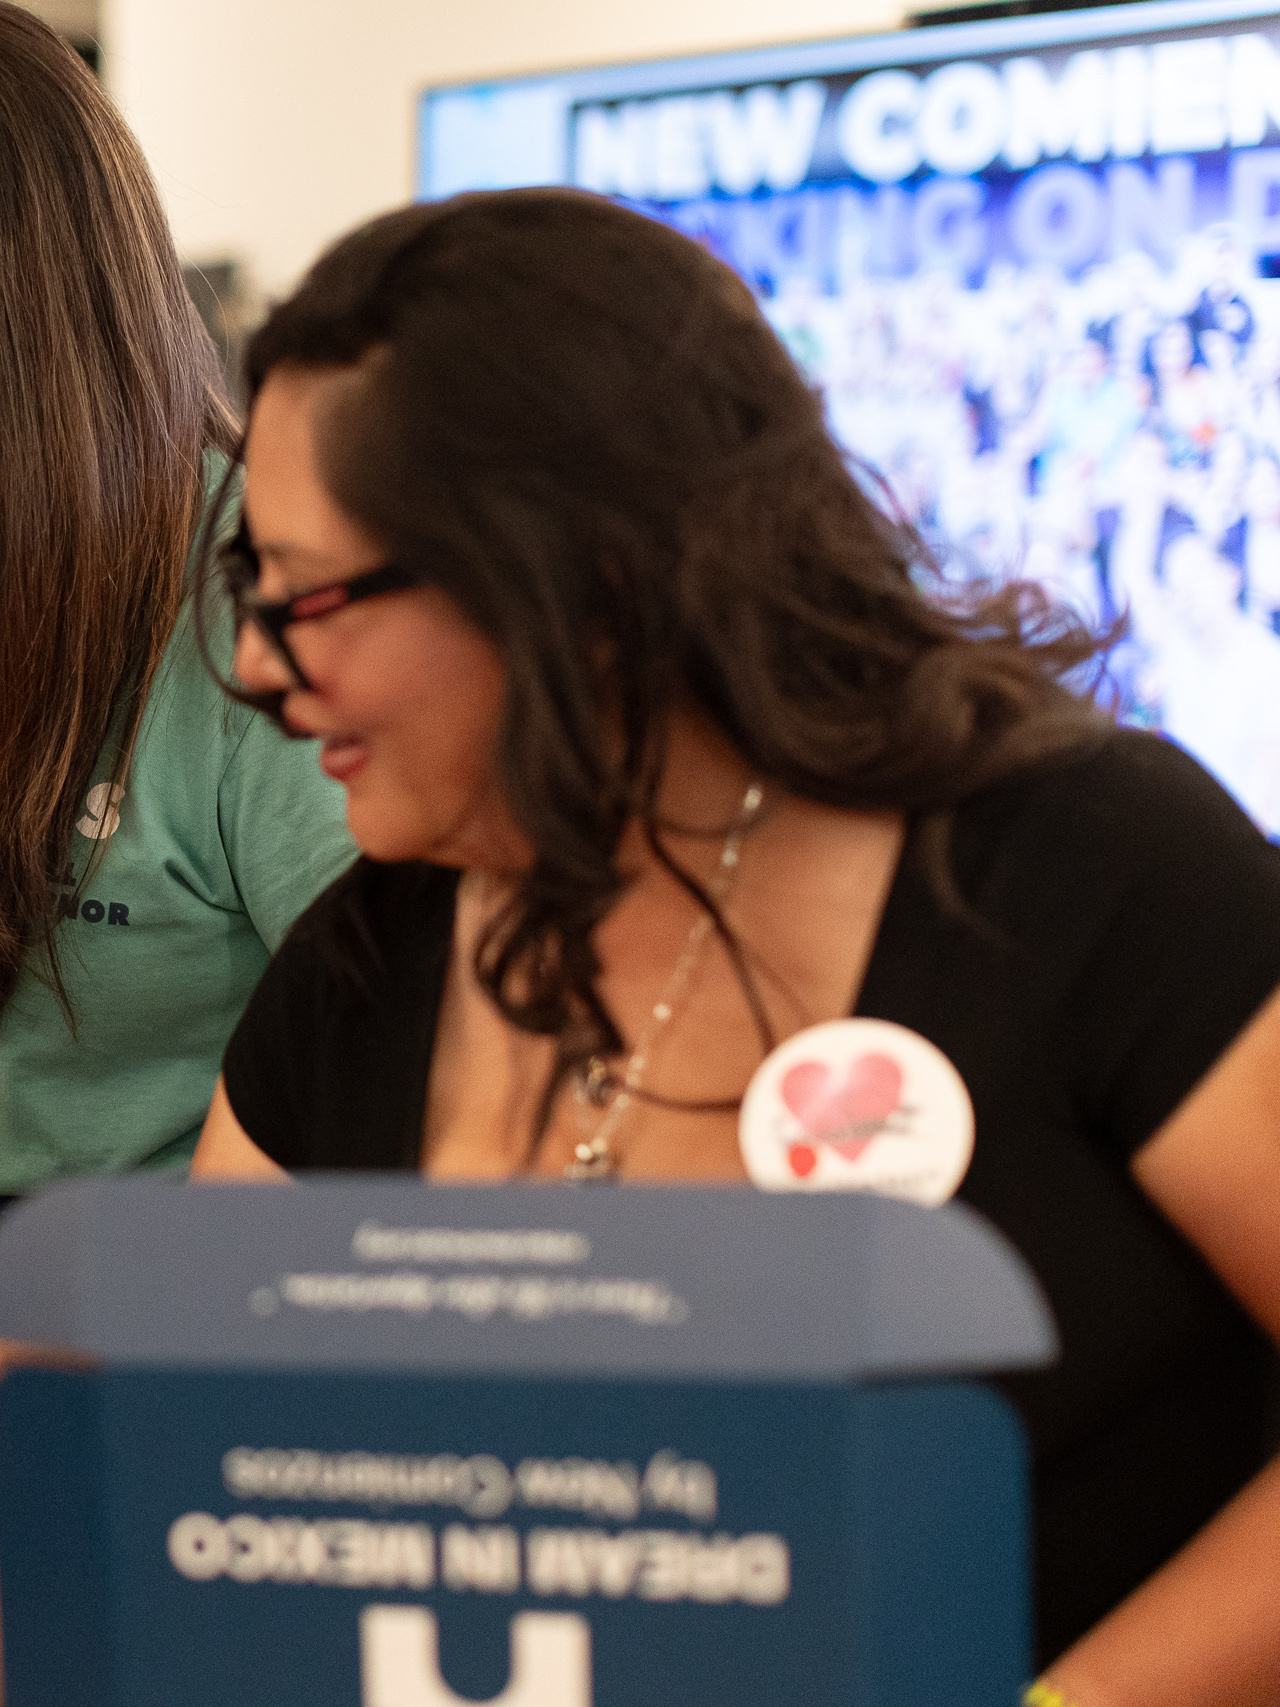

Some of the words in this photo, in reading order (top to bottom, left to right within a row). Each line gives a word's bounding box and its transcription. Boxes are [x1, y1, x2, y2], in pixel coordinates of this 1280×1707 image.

[573, 83, 824, 198] NEW
[1017, 158, 1195, 270] ON
[223, 1446, 512, 1520] Comienzos
[516, 1457, 641, 1522] New
[168, 1511, 437, 1591] MEXICO
[439, 1521, 521, 1595] IN
[525, 1528, 791, 1606] DREAM
